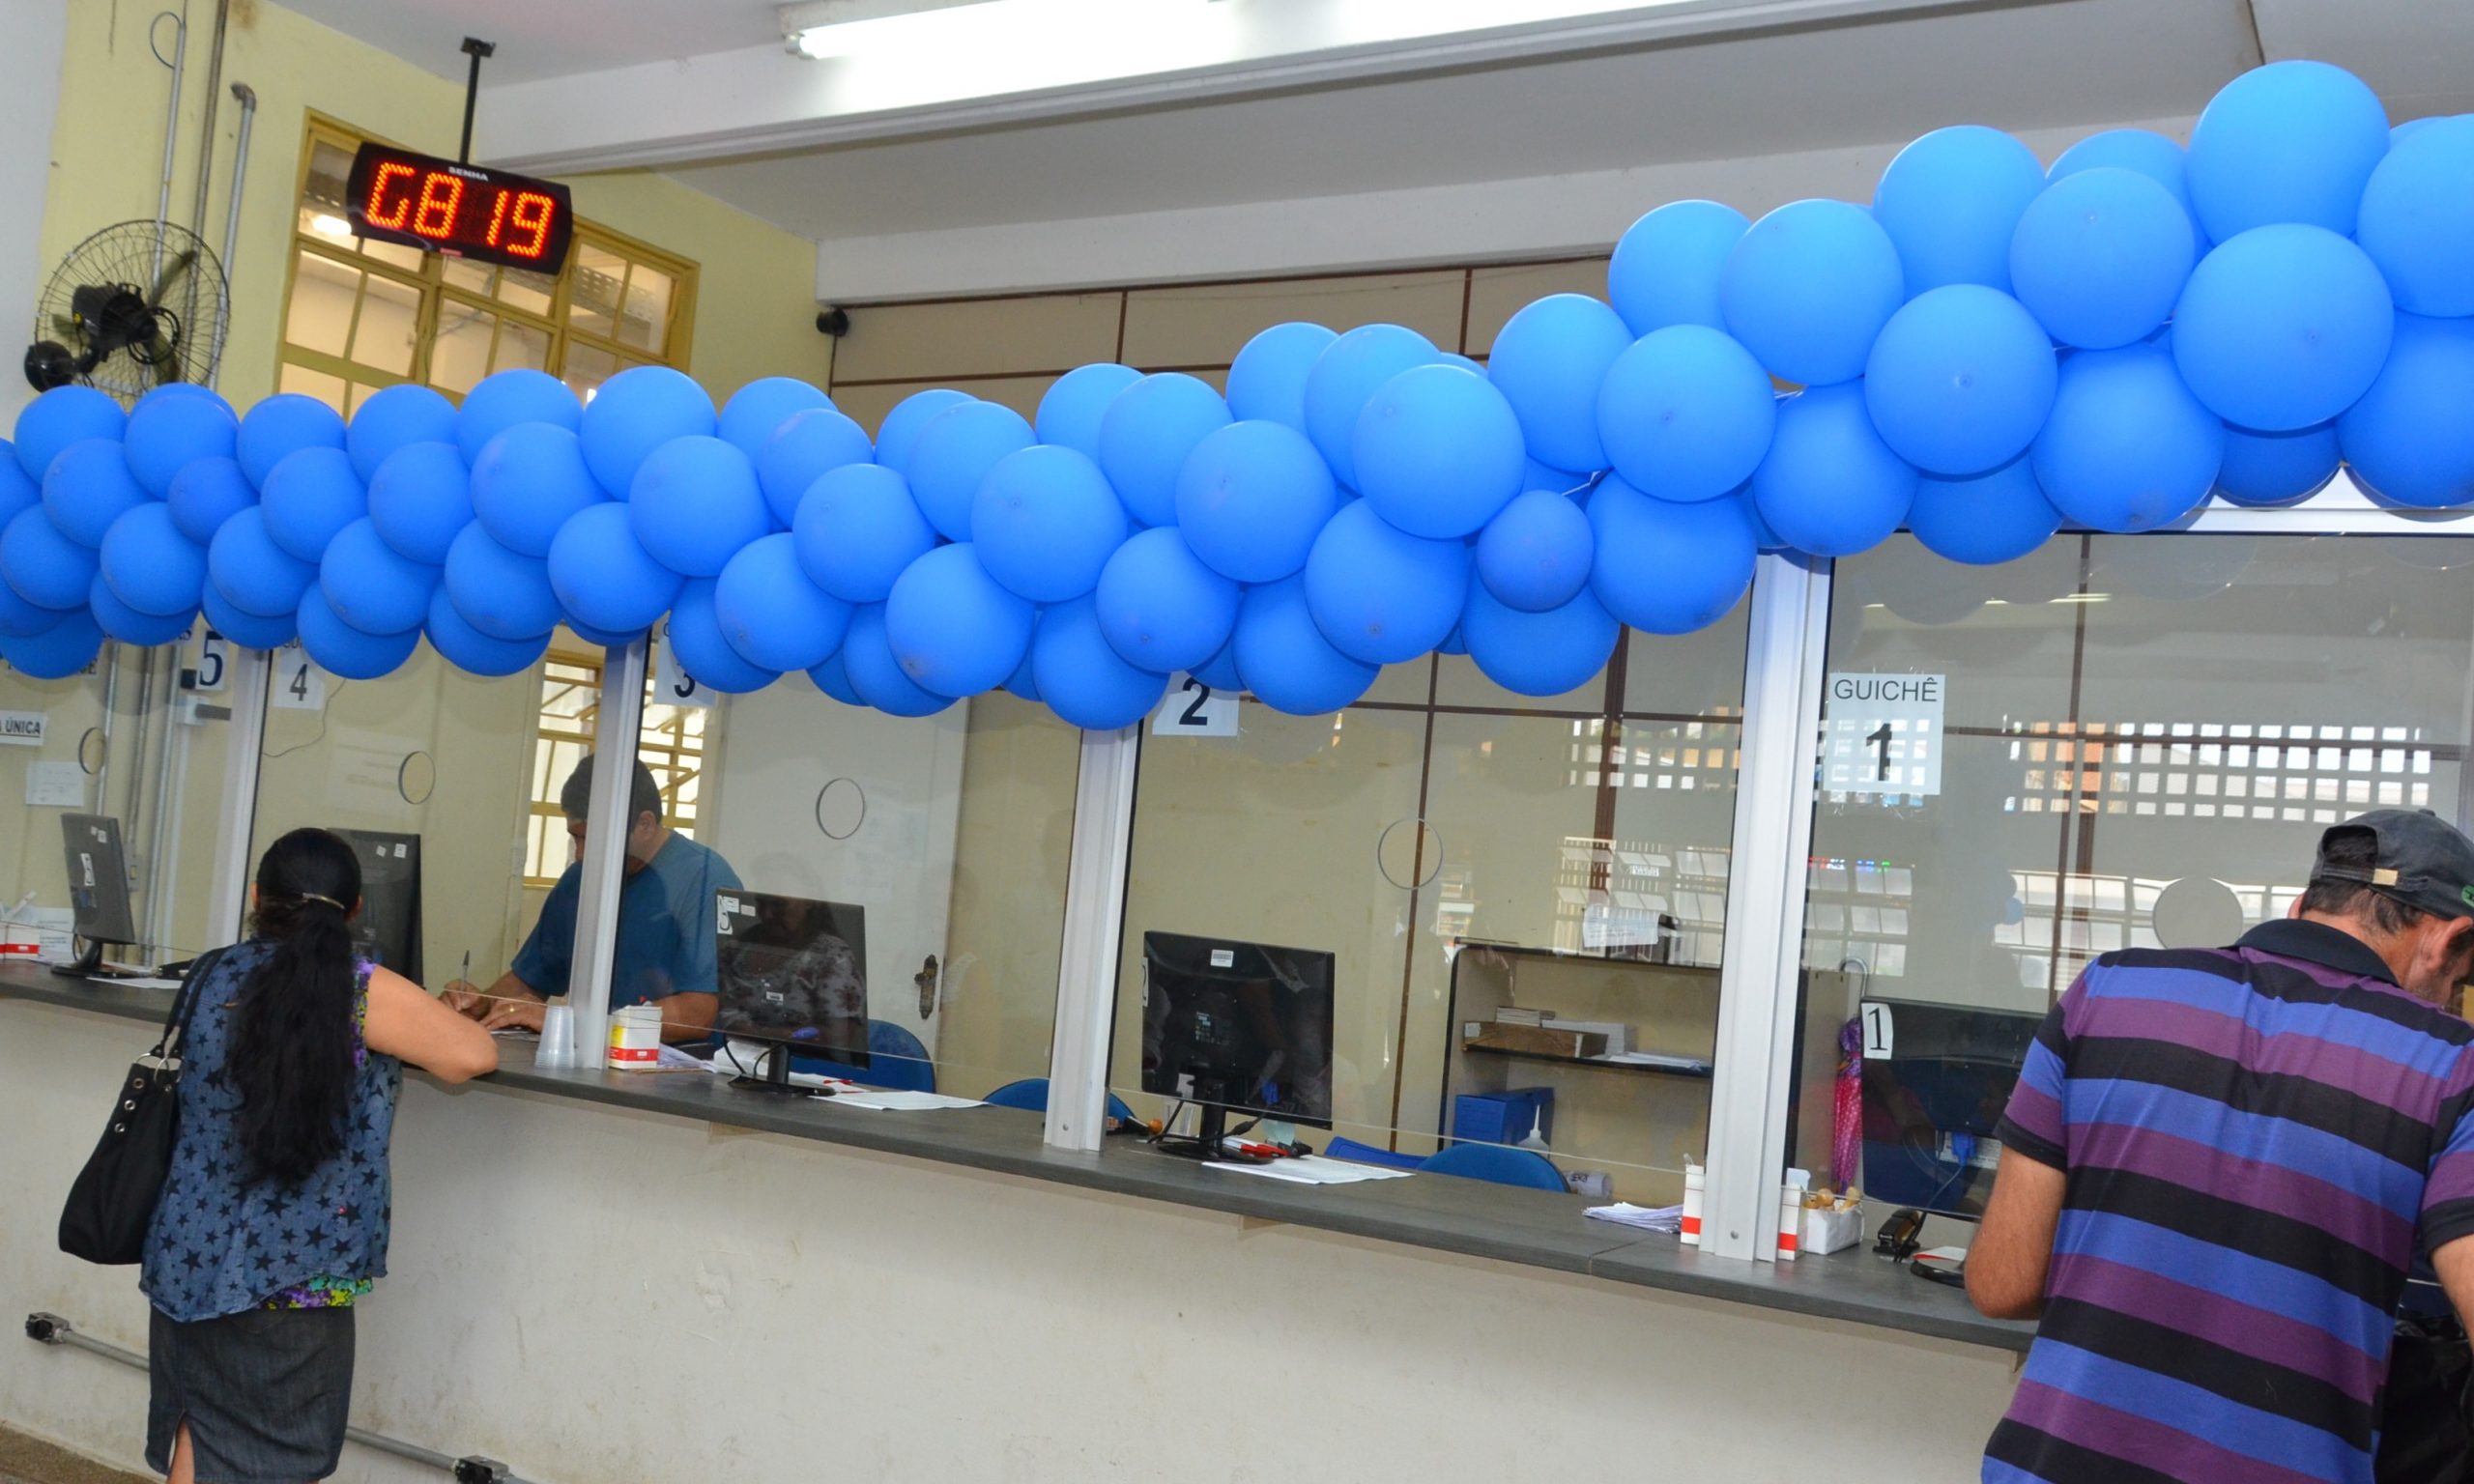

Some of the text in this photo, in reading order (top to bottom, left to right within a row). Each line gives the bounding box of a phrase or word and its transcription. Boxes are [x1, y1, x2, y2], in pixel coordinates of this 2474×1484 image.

[199, 630, 223, 687] 5
[290, 664, 308, 701] 4
[1179, 677, 1211, 726] 2
[1834, 677, 1938, 701] GUICHÊ
[5, 717, 41, 734] ÚNICA
[1865, 723, 1892, 782] 1
[1868, 1007, 1888, 1051] 1
